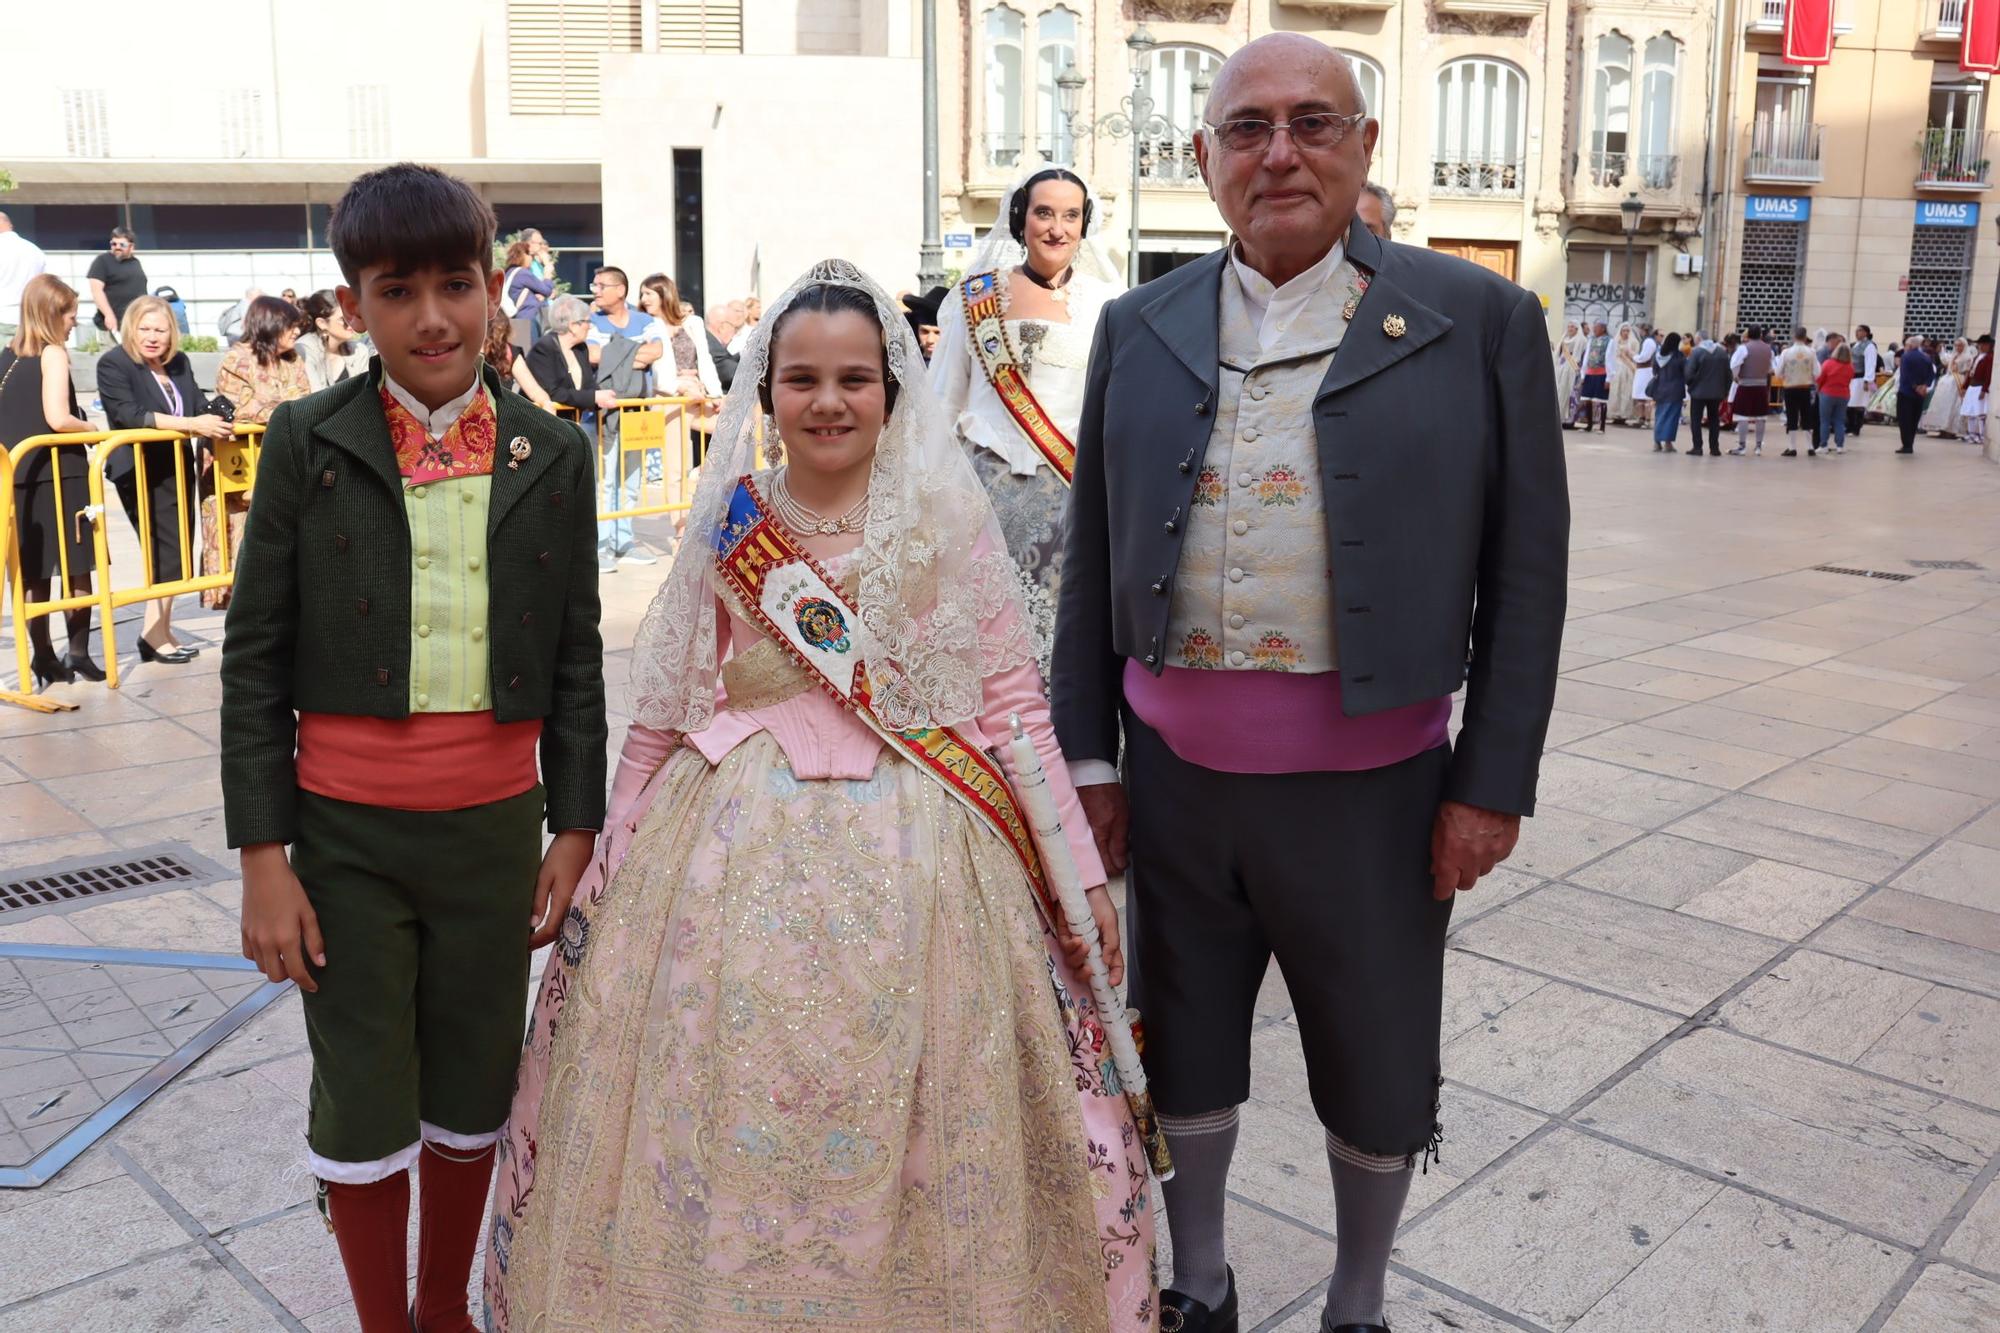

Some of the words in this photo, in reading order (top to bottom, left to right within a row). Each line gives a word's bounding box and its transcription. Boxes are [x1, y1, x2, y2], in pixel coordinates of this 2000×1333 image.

[1754, 198, 1798, 213] UMAS
[1924, 203, 1967, 218] UMAS
[231, 455, 243, 476] 2
[776, 578, 808, 611] 2024
